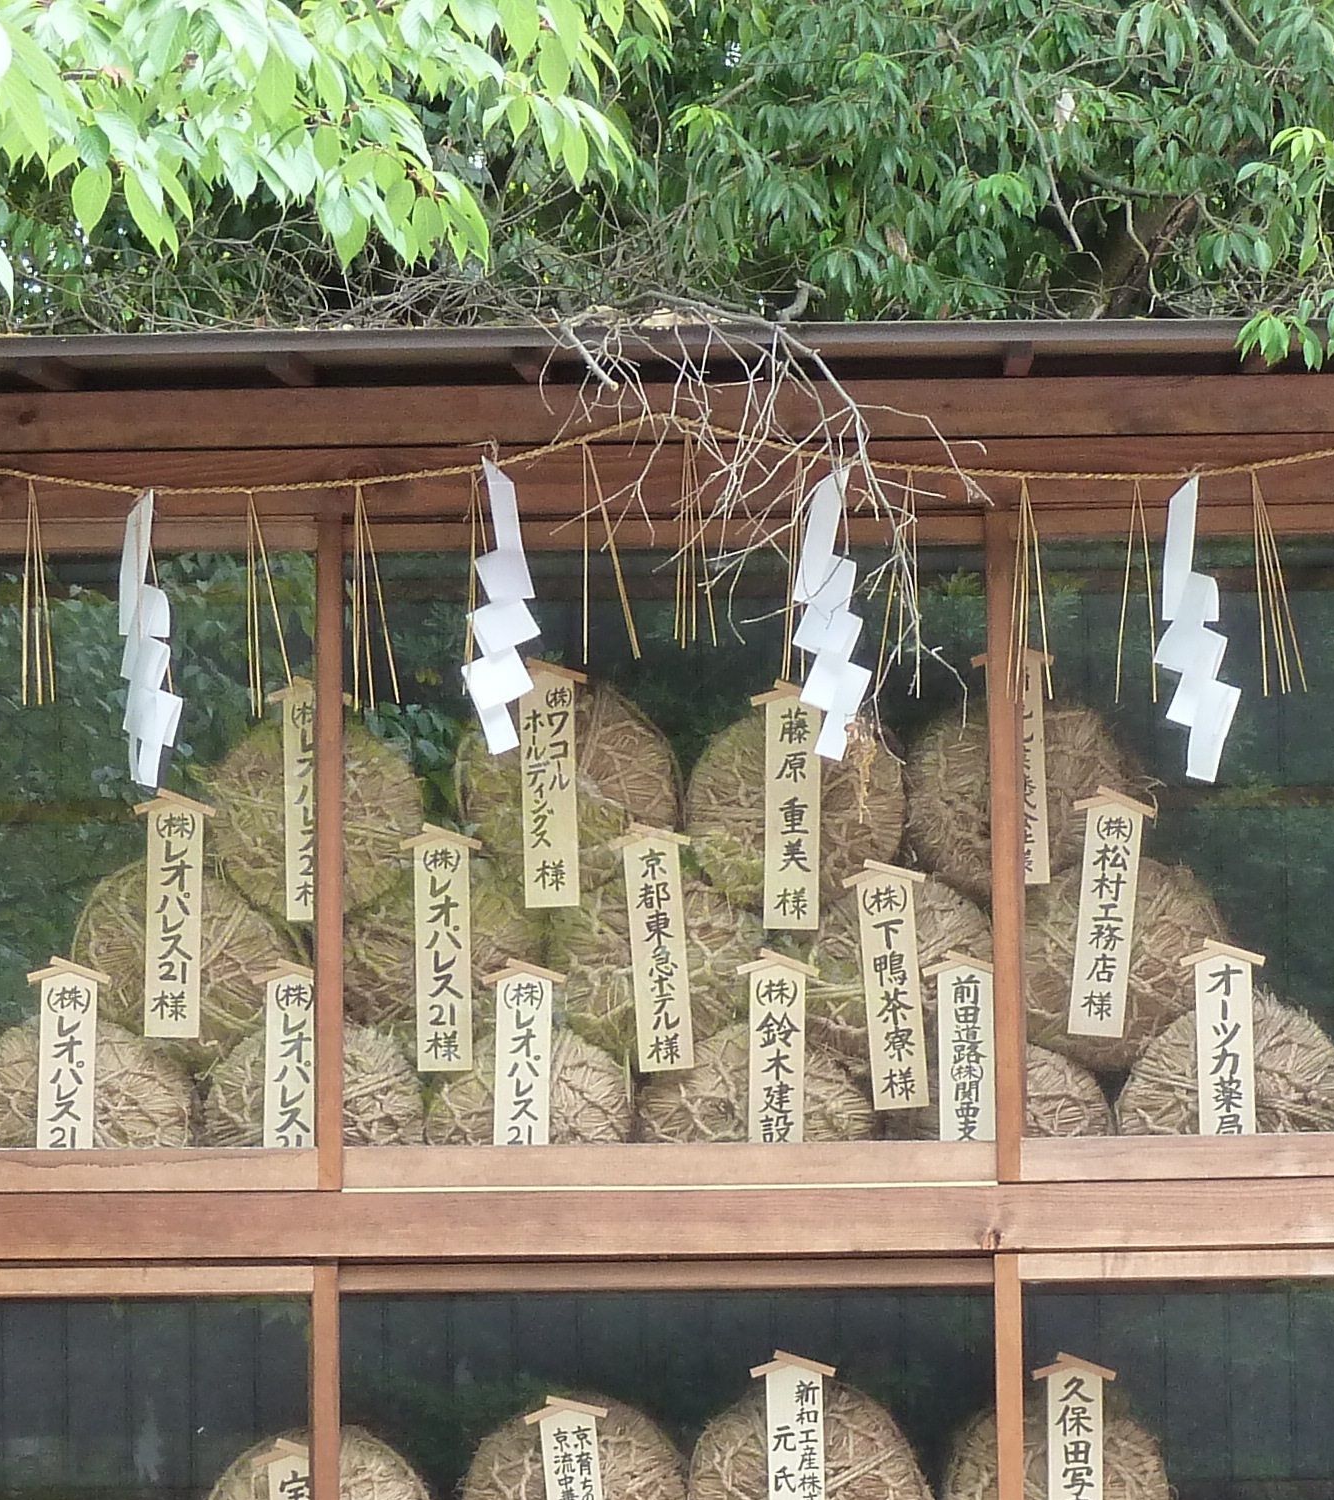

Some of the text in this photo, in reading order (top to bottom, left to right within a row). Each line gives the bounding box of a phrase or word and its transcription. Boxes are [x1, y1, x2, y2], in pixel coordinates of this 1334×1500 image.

[150, 811, 197, 1022] (株)レオパレス21様
[773, 707, 813, 921] 藤原重美様
[1080, 814, 1134, 1022] (株)松村工務店様
[423, 847, 463, 1062] (株)レオパレス21様
[636, 848, 681, 1065] 京都東急ホテル様
[862, 884, 916, 1102] (株)下鴨茶寮様
[1205, 963, 1244, 1135] オーツカ薬局
[46, 985, 91, 1149] (株)レオパレス21
[503, 981, 544, 1145] (株)レオパレス21
[756, 978, 801, 1143] (株)鈴木建設
